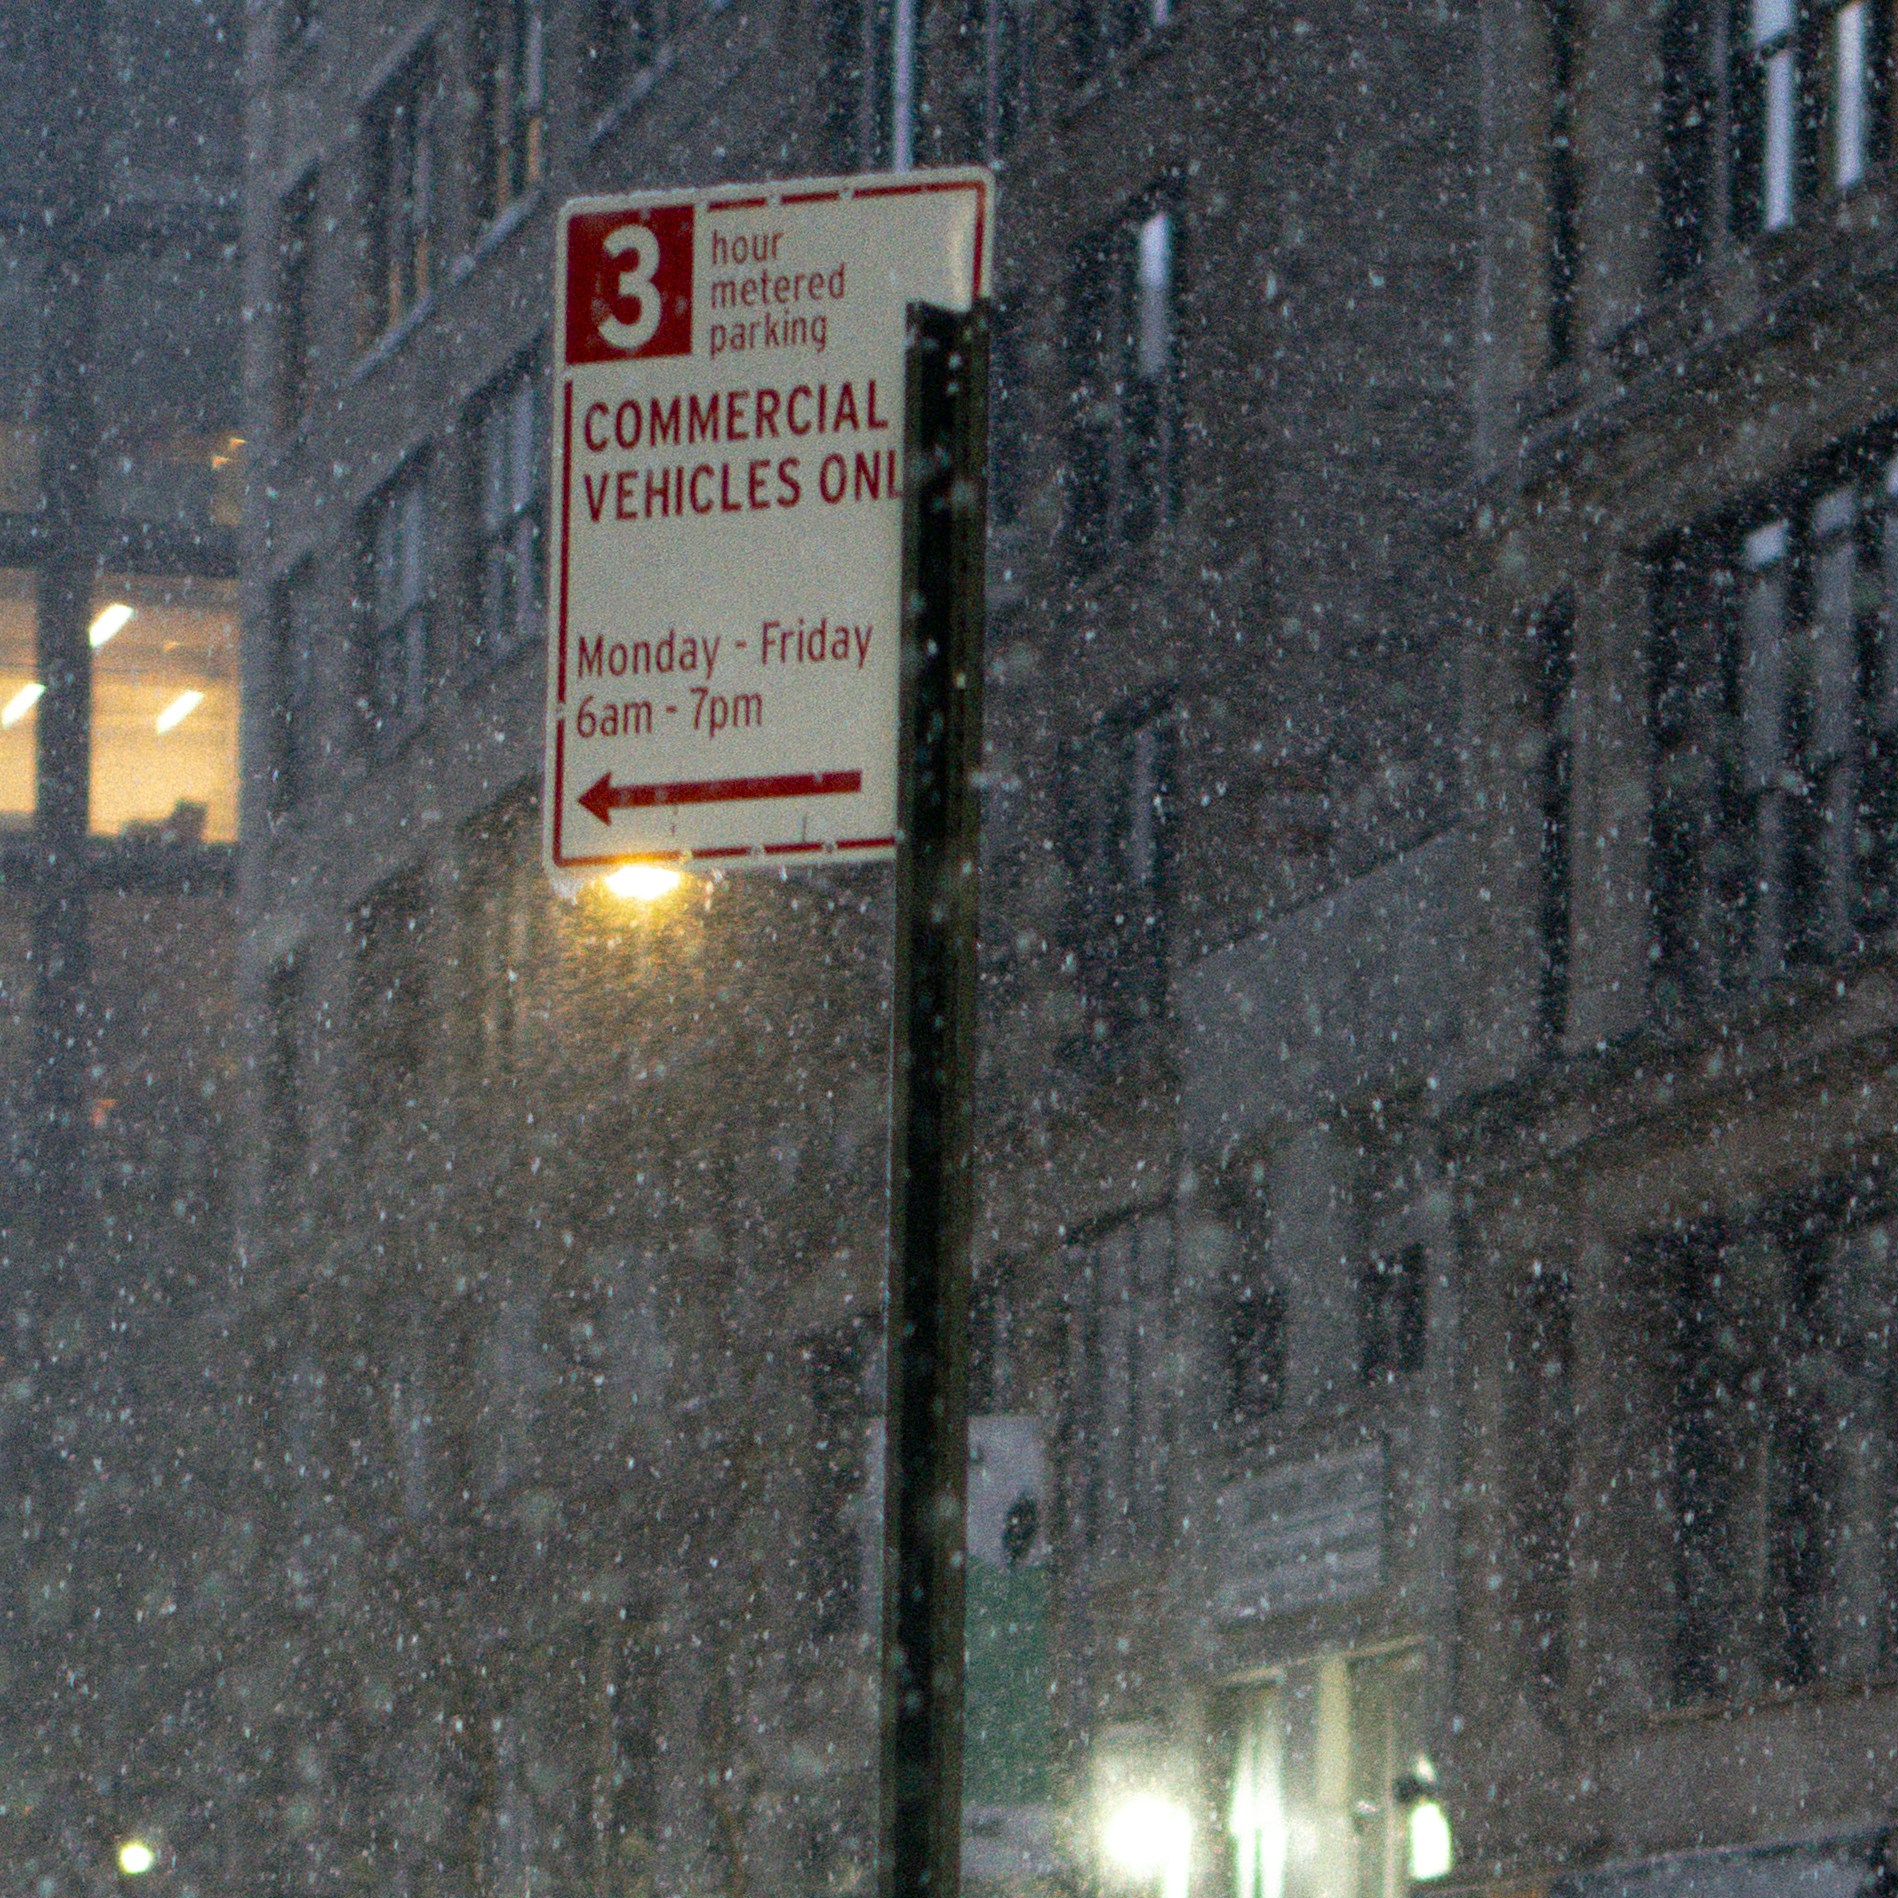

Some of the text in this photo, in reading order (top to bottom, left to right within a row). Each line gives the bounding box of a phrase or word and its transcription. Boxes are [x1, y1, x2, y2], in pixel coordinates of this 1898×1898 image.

[710, 228, 785, 266] hour
[597, 222, 662, 351] 3
[709, 260, 846, 309] metered
[709, 309, 827, 360] parking
[584, 378, 889, 453] COMMERCIAL
[583, 449, 901, 523] VEHICLES ONL
[577, 627, 721, 680] Monday
[762, 616, 874, 670] Friday
[576, 694, 653, 739] 6am
[689, 686, 763, 740] 7pm
